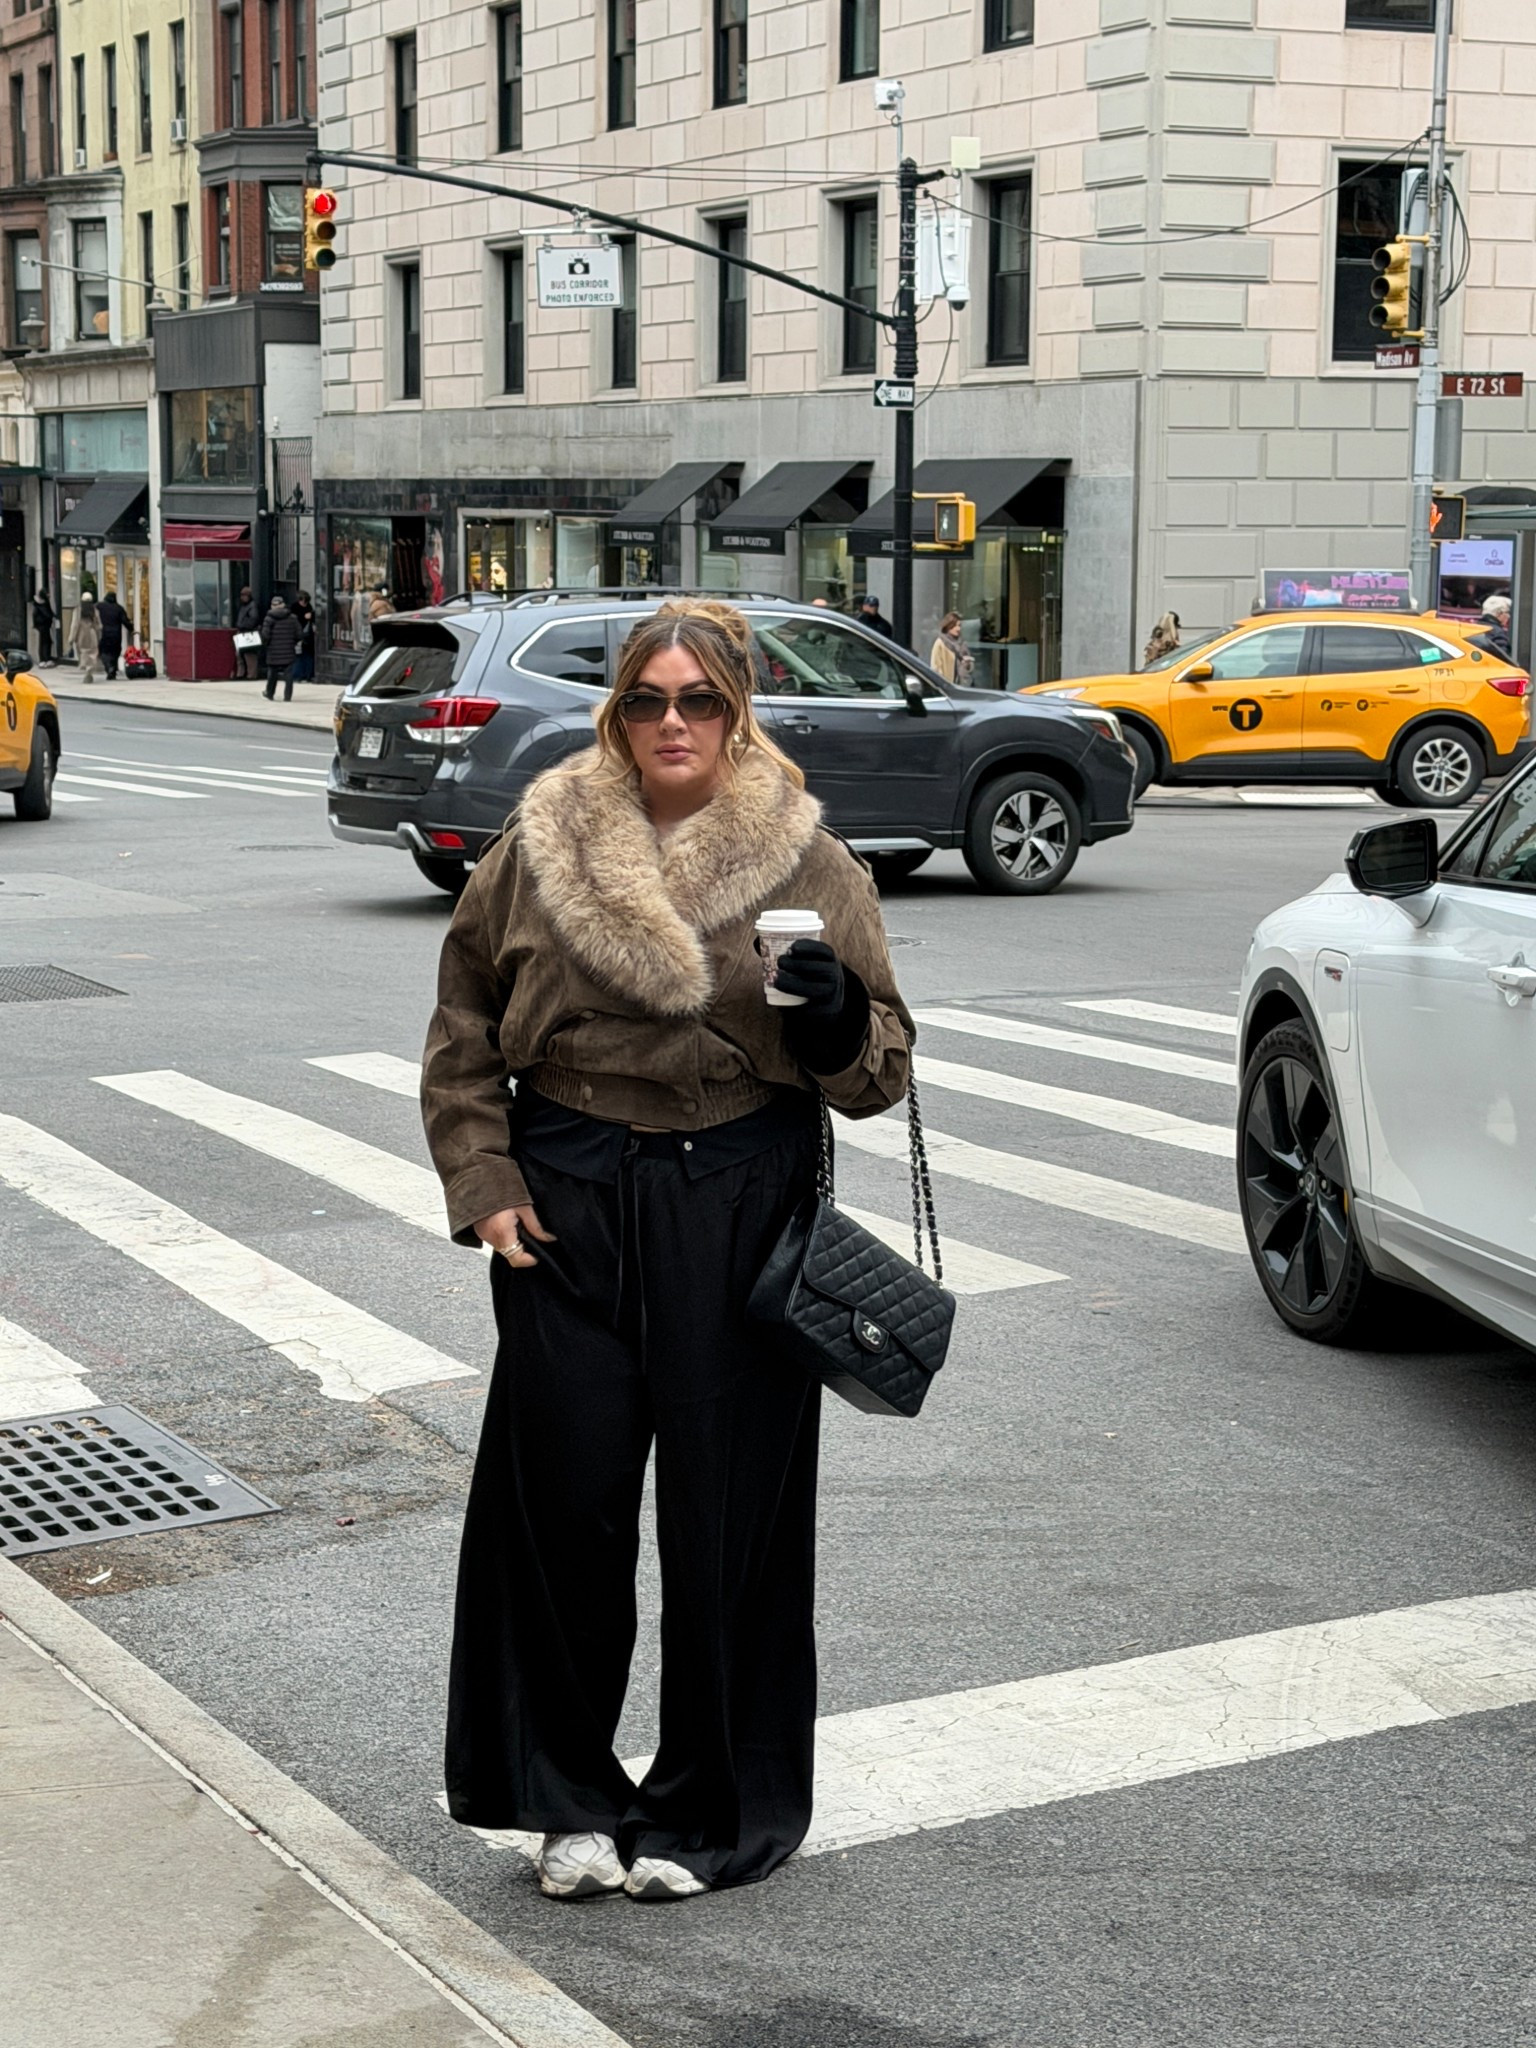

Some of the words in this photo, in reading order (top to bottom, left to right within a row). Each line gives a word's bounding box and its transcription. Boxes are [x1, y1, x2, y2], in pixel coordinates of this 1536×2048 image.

[550, 280, 566, 290] BUS
[569, 279, 609, 289] CORRIDOR
[545, 294, 572, 303] PHOTO
[573, 293, 615, 303] ENFORCED
[1376, 351, 1403, 366] Madison
[1403, 349, 1414, 366] Av
[1456, 378, 1465, 394] E
[1469, 378, 1486, 394] 72
[1489, 378, 1505, 394] St
[880, 388, 892, 399] ONE
[898, 389, 910, 399] WAY
[1236, 704, 1256, 727] T
